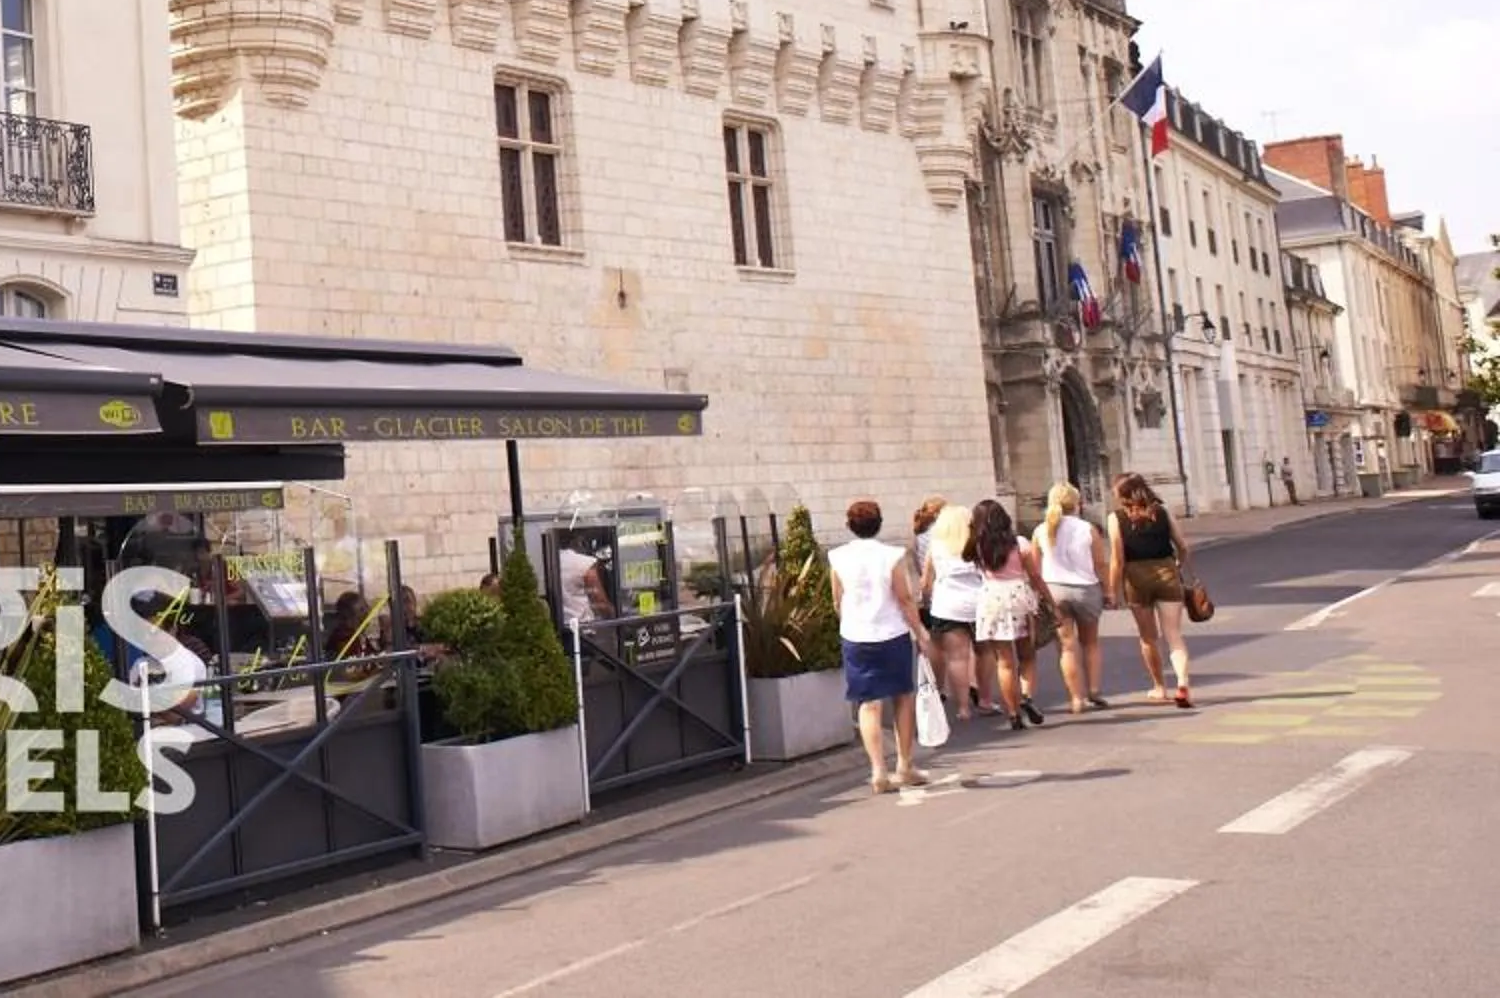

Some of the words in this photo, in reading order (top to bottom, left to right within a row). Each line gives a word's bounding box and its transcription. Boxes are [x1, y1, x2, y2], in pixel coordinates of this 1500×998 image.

[291, 417, 349, 437] BAR
[374, 417, 483, 437] GLACIER
[499, 417, 572, 436] SALON
[580, 416, 606, 435] DE
